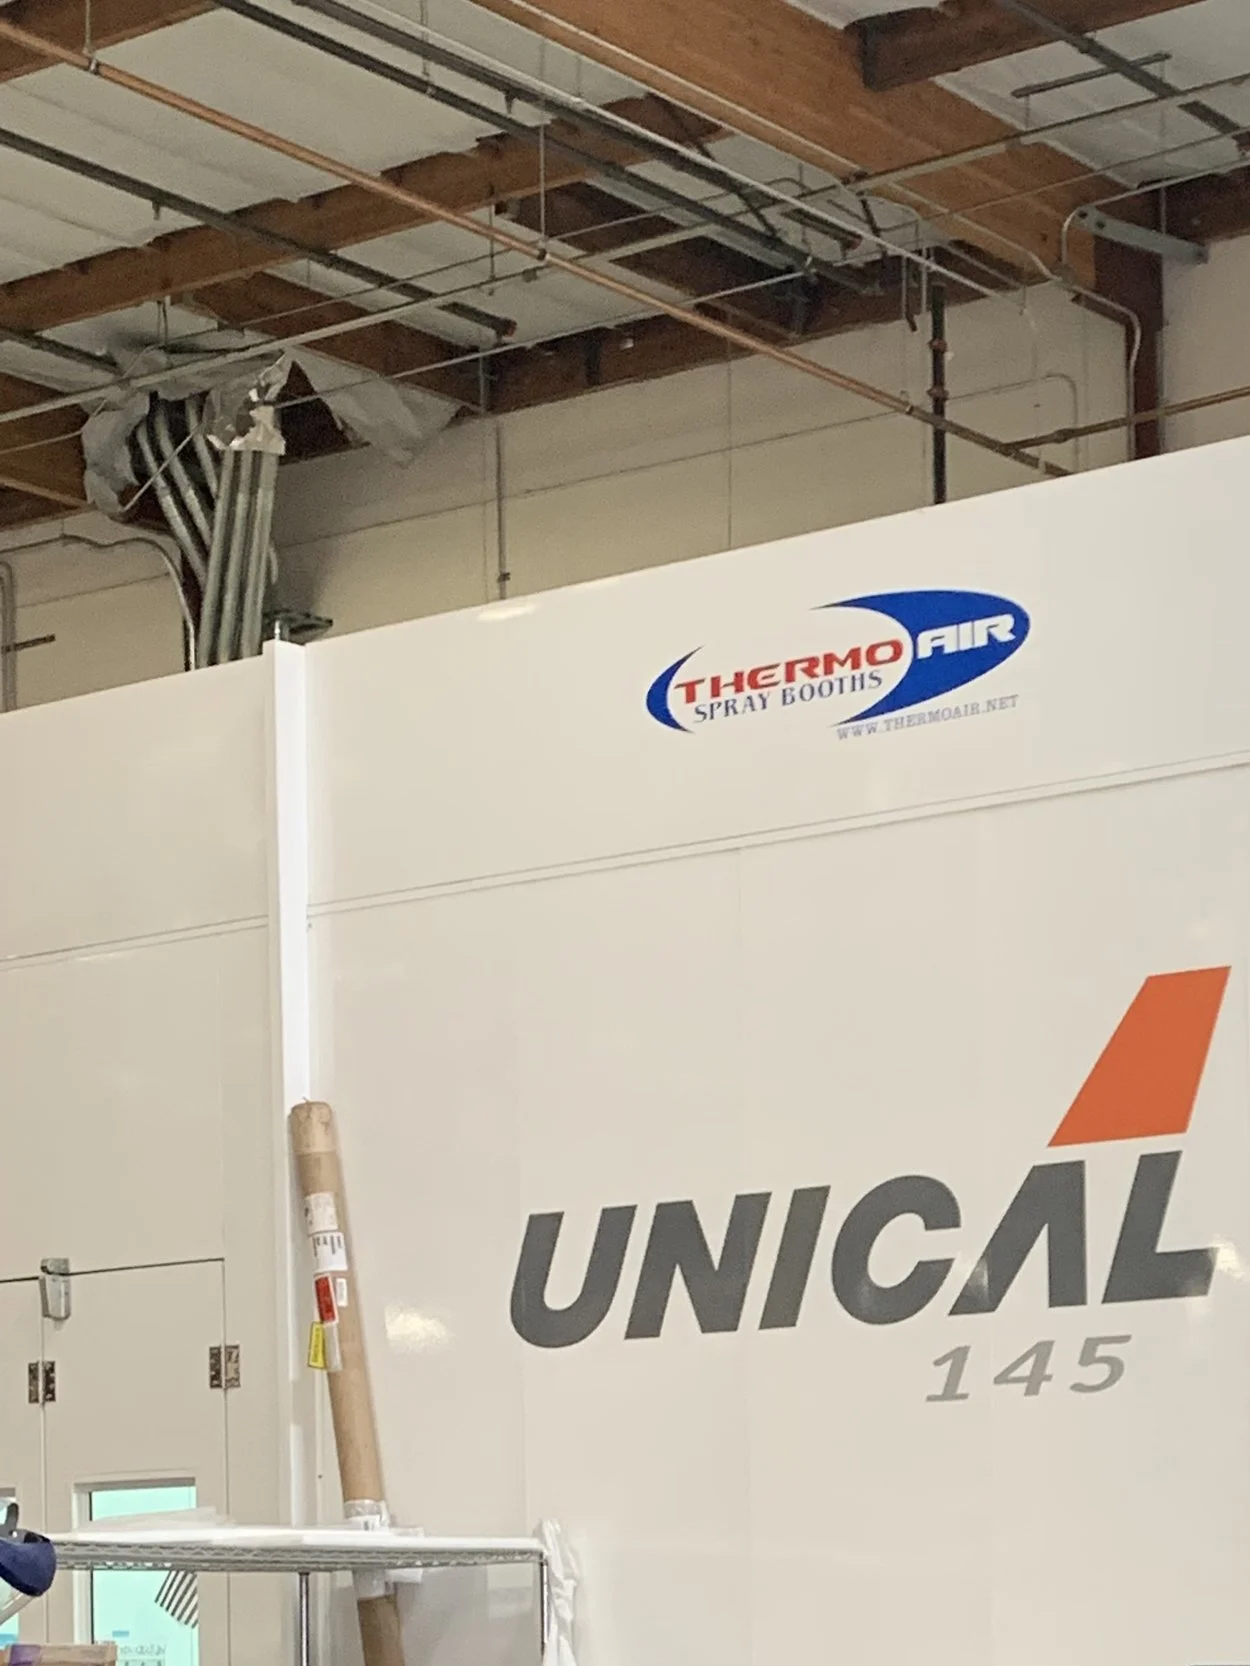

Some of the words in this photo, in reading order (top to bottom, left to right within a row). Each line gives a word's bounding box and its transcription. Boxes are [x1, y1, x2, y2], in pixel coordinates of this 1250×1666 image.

[673, 639, 904, 704] THERMO
[916, 613, 1017, 660] AIR
[692, 691, 771, 724] SPRAY
[781, 669, 883, 707] BOOTHS
[836, 695, 1020, 741] WWW.THERMOAIR.NET
[510, 1150, 1222, 1349] UNICAL
[925, 1333, 1133, 1403] 145
